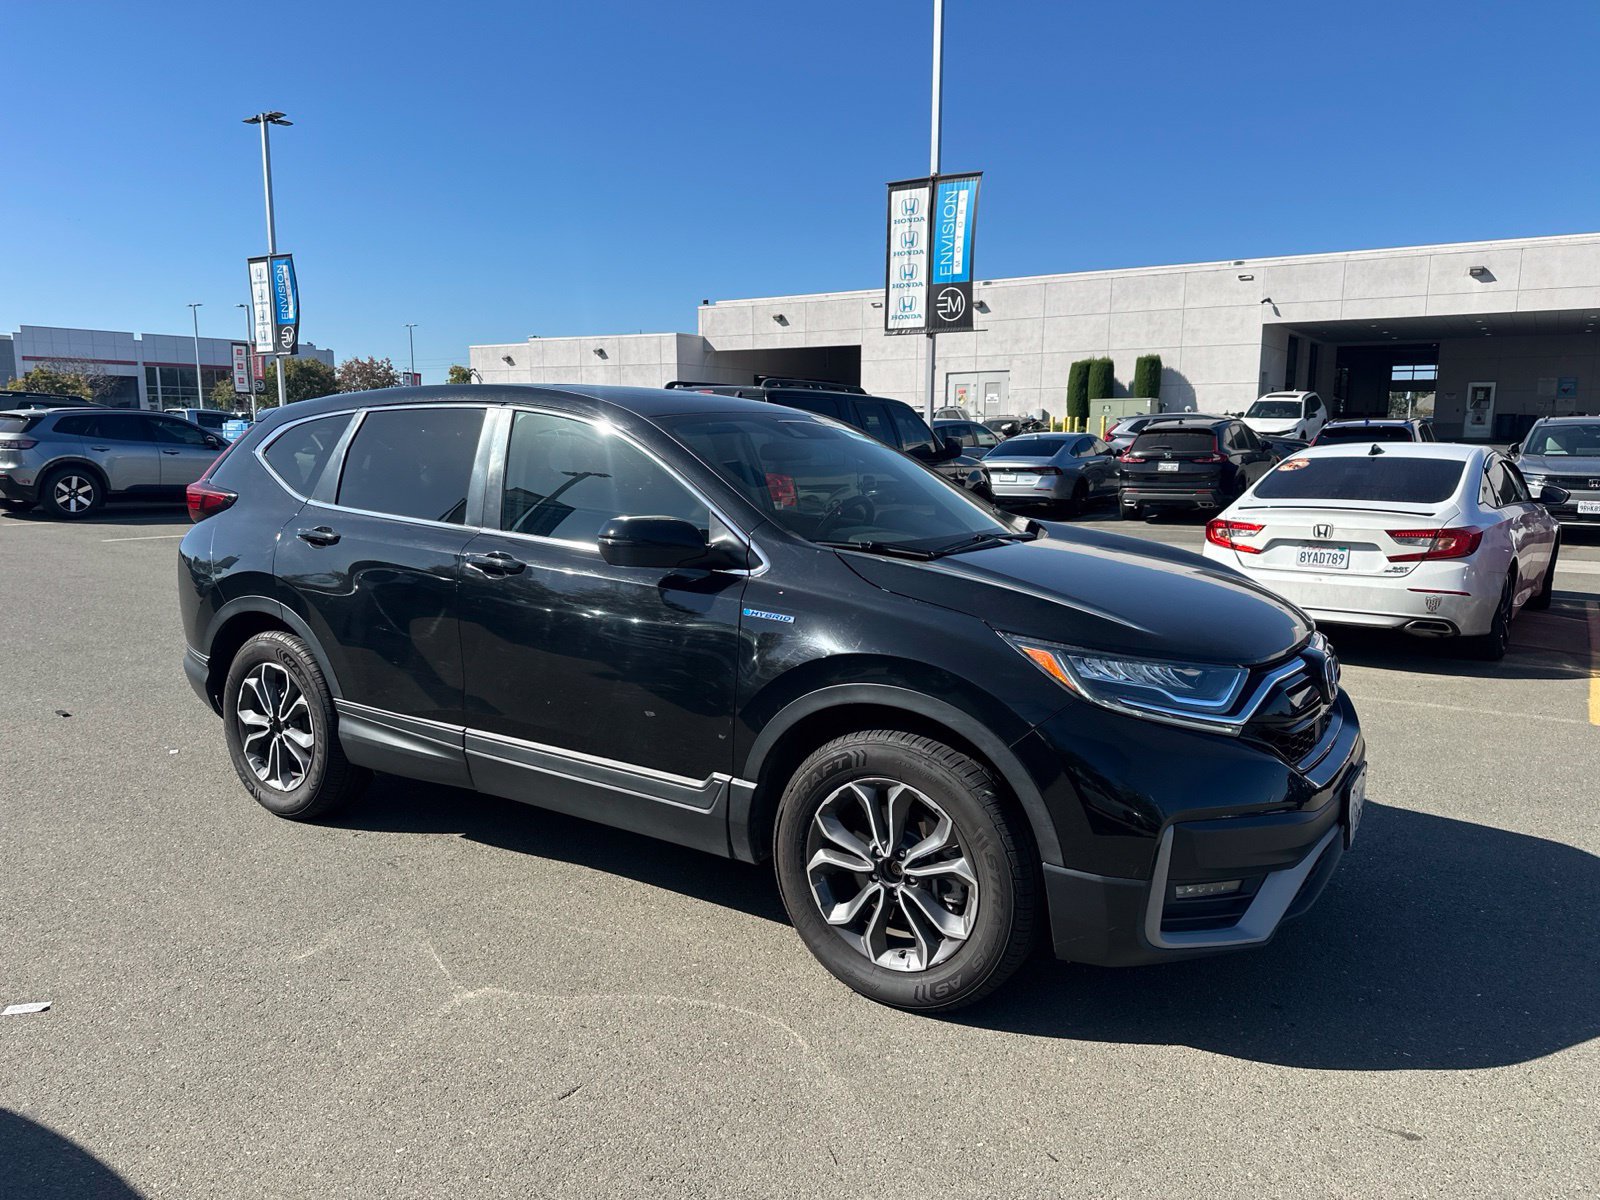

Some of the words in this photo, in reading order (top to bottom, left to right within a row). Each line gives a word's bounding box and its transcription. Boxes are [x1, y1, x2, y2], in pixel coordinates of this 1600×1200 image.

[894, 216, 925, 225] HONDA
[940, 190, 958, 276] ENVISION
[955, 197, 966, 268] MOTORS
[893, 249, 924, 257] HONDA
[892, 281, 924, 289] HONDA
[277, 265, 288, 320] ENVISION
[891, 313, 922, 321] HONDA
[1299, 551, 1345, 565] 8YAD789
[750, 609, 792, 622] HYBRID
